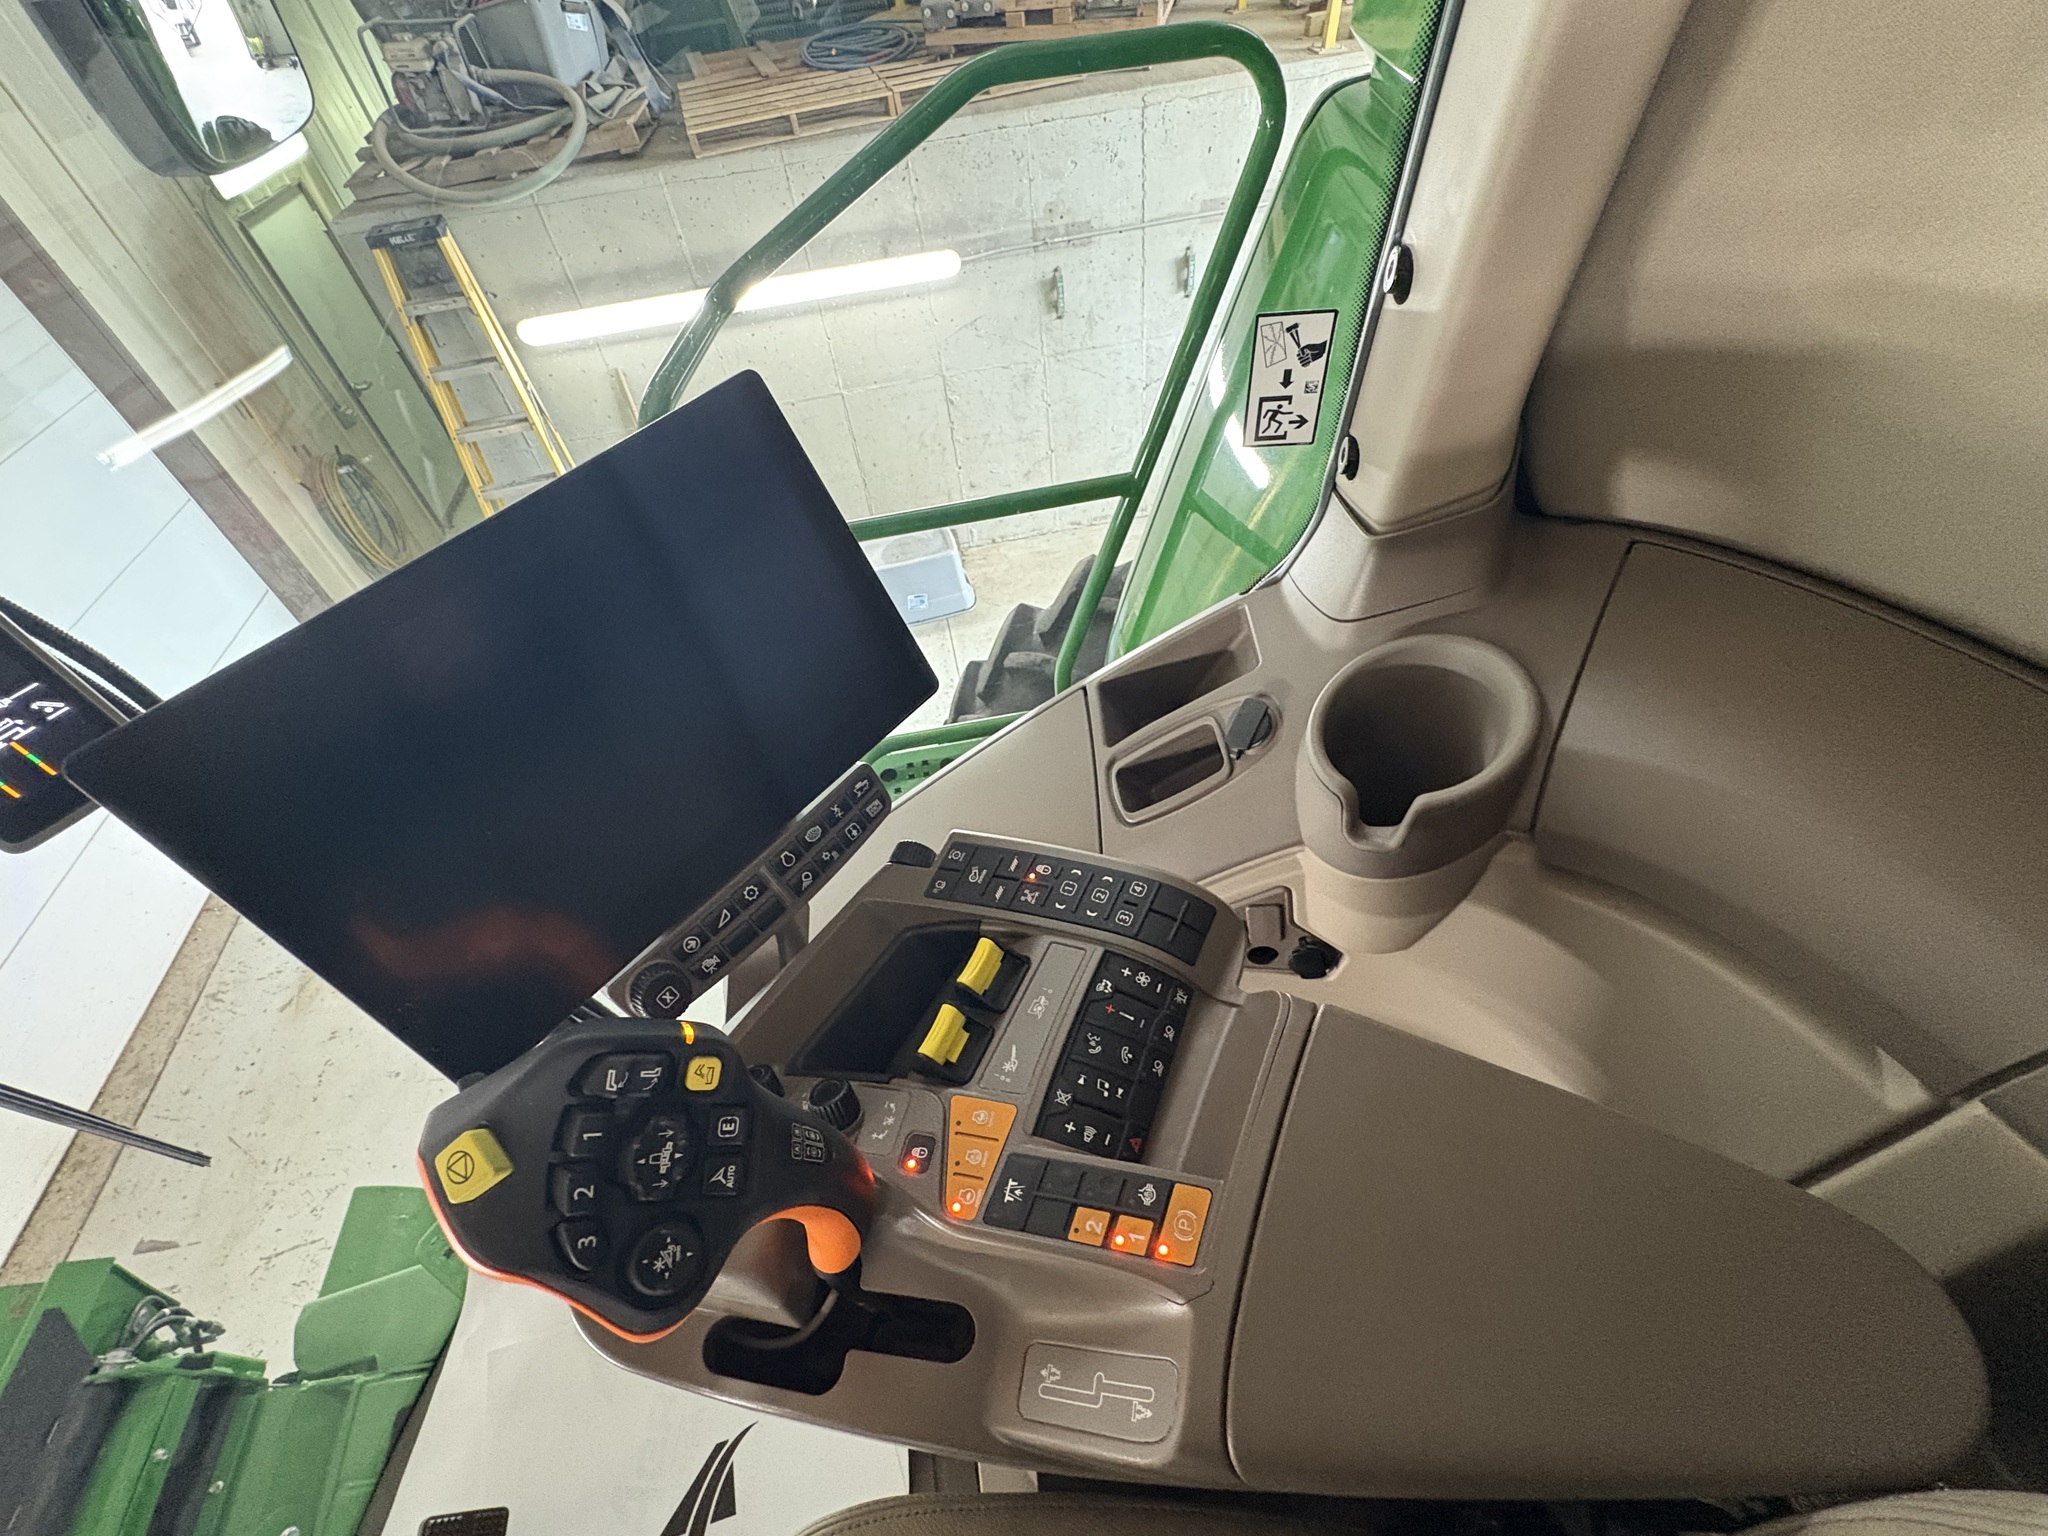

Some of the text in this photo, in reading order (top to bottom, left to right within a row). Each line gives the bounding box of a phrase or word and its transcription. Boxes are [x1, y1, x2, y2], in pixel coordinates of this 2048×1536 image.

[1133, 885, 1143, 893] 4
[1119, 914, 1129, 922] 3
[722, 1122, 735, 1131] E
[582, 1132, 602, 1140] 1
[726, 1165, 736, 1188] AUTO
[573, 1184, 594, 1200] 2
[1085, 1219, 1103, 1235] 2
[1178, 1219, 1192, 1231] P
[577, 1235, 597, 1249] 3
[1128, 1232, 1146, 1243] 1
